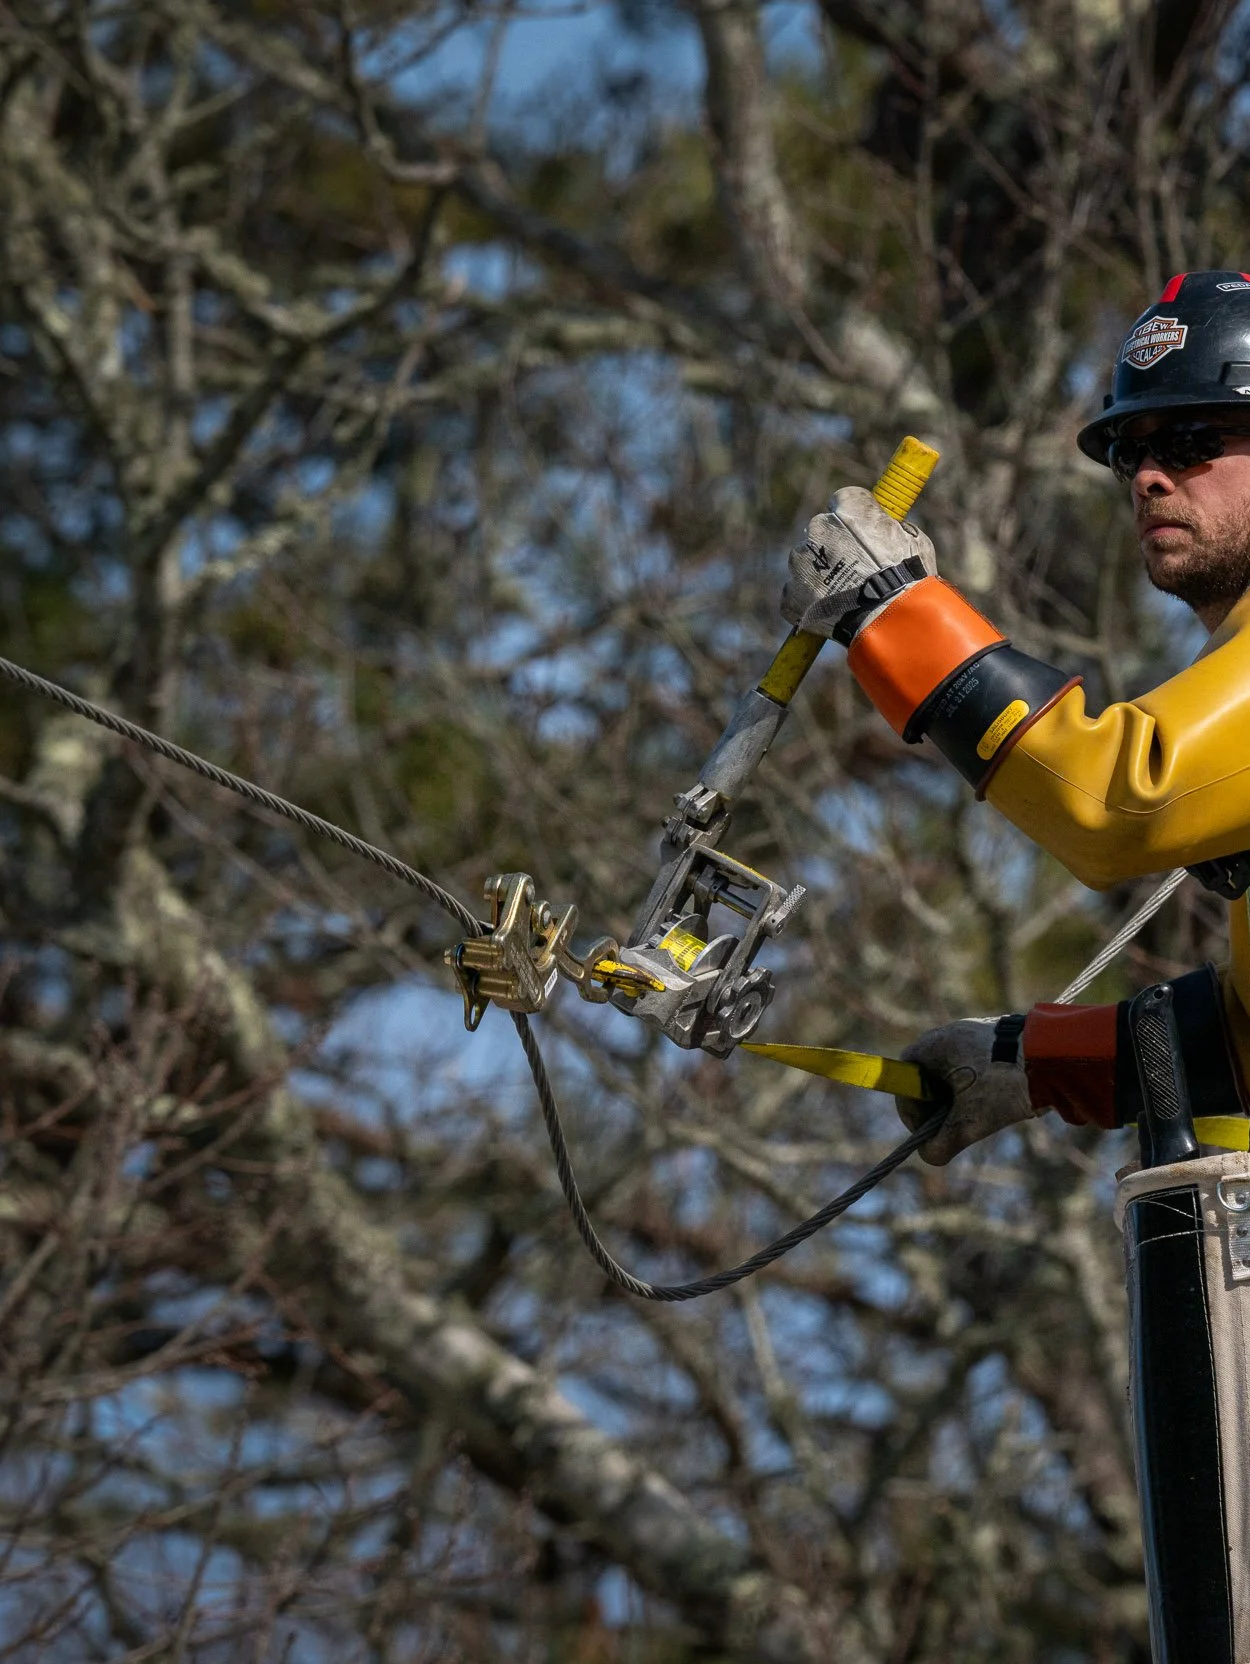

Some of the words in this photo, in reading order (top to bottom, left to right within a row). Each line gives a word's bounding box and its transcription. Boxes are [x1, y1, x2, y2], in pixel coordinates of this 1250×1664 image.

[1139, 321, 1168, 335] IBEW
[1150, 331, 1180, 344] WORKERS
[1133, 347, 1153, 362] LOCAL
[823, 559, 845, 586] CHANCE
[962, 677, 980, 694] 2025
